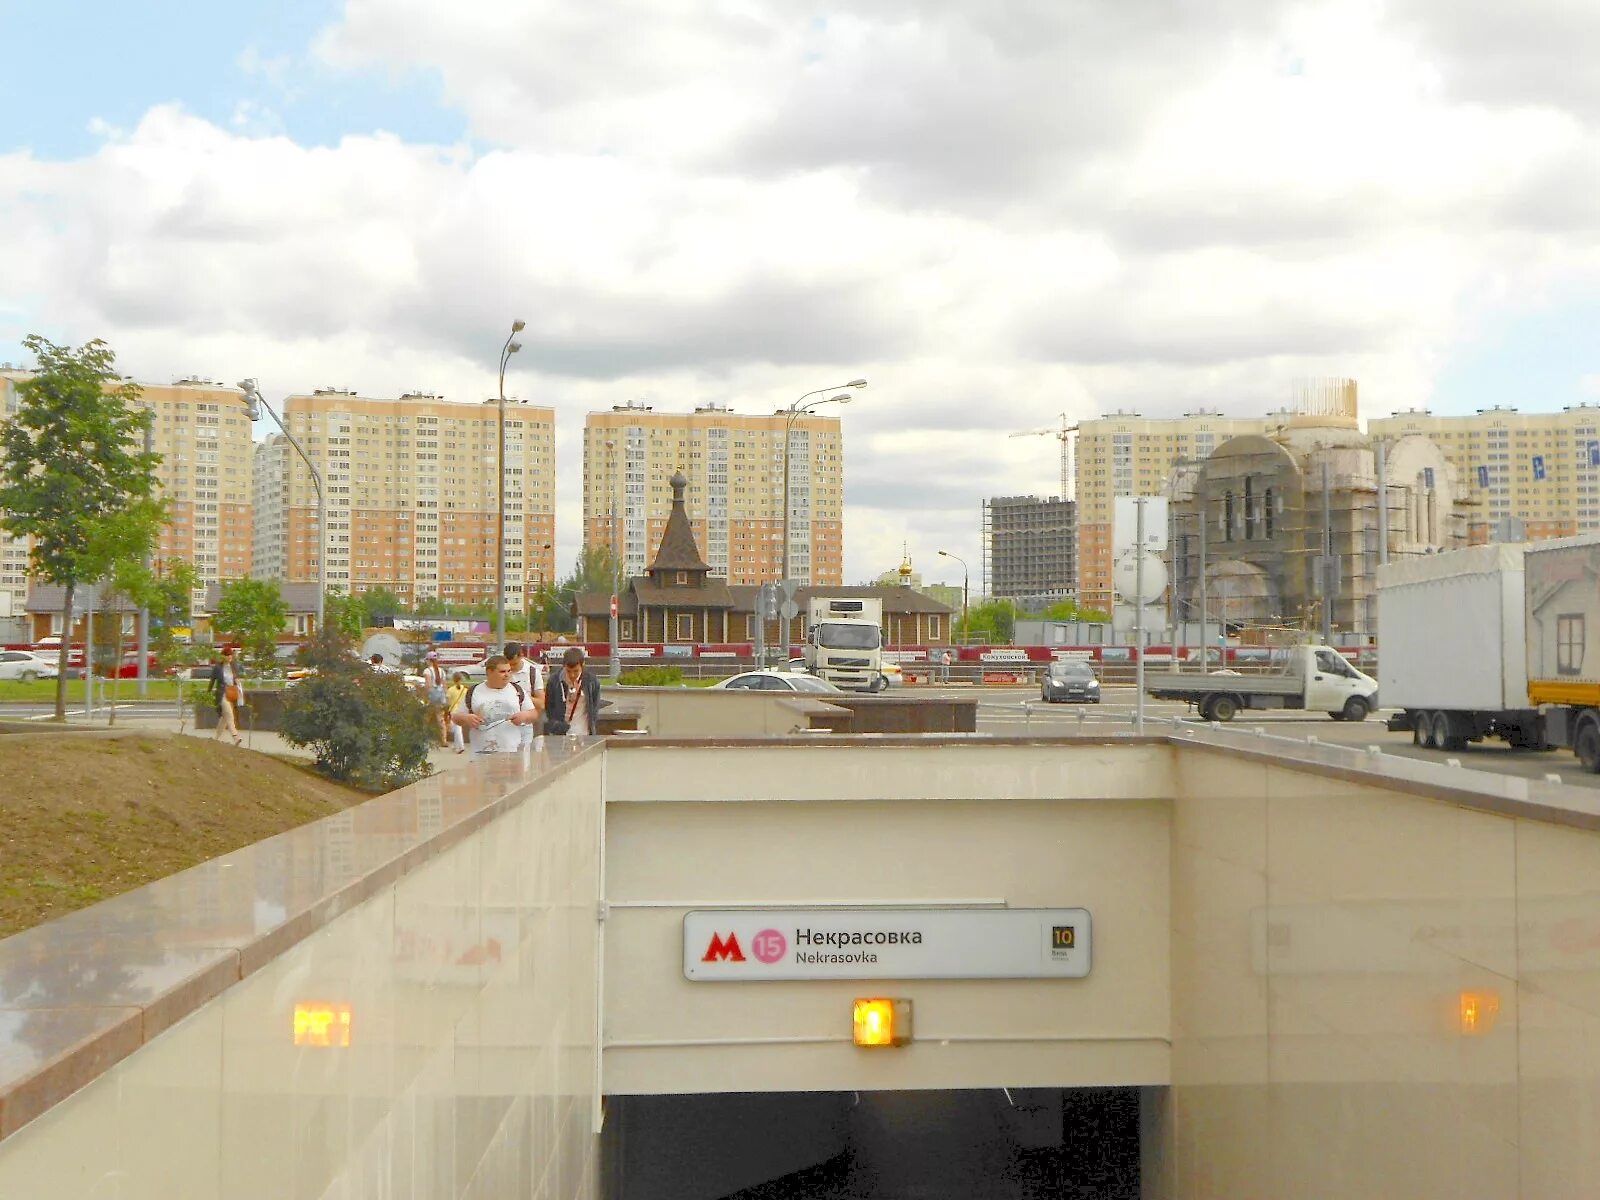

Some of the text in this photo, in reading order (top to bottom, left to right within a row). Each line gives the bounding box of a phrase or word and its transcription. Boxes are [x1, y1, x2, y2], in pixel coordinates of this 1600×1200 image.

[756, 936, 781, 957] 15
[796, 928, 923, 949] Некрасовка
[1055, 930, 1072, 945] 10
[796, 951, 878, 964] Nekrasovka
